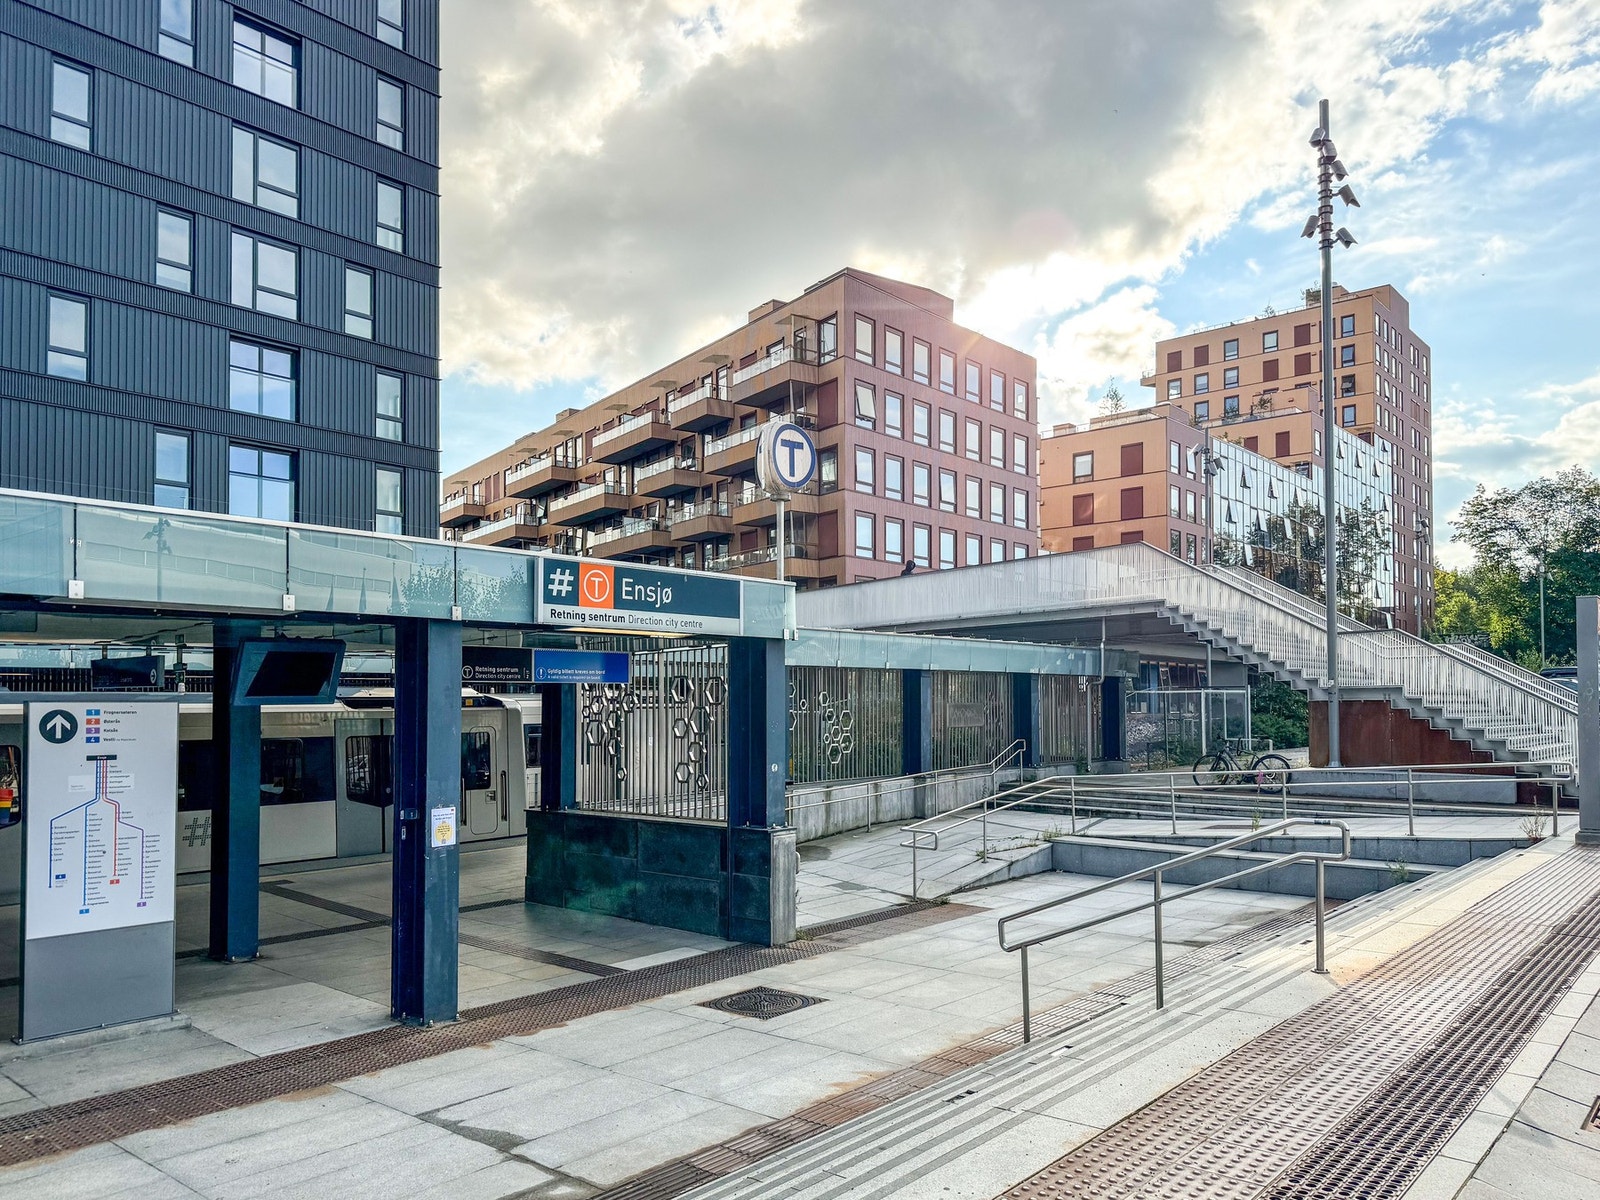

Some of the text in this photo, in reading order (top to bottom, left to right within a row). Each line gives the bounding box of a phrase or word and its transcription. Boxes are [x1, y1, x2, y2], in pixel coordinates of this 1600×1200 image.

[622, 577, 672, 608] Ensjø
[550, 608, 703, 629] Retning sentrum Direction city centre
[475, 666, 496, 674] Retning
